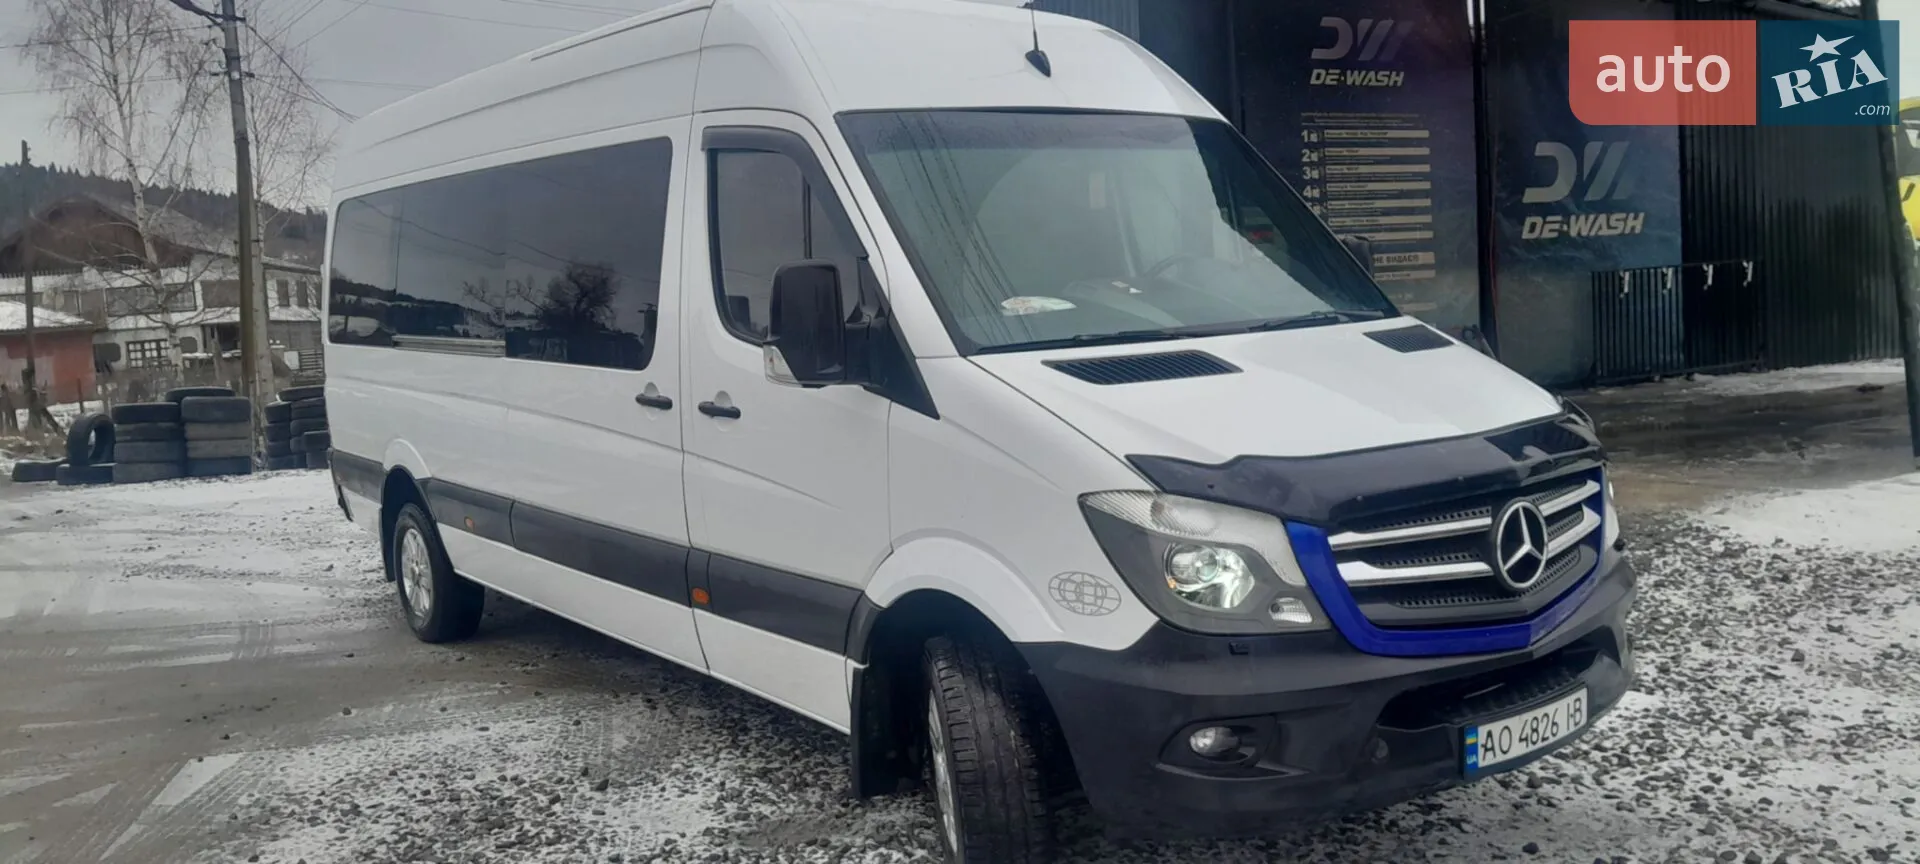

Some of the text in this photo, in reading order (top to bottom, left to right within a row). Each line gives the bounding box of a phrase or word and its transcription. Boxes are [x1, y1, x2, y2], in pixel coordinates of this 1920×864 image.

[1301, 148, 1311, 162] 2
[1302, 166, 1312, 180] 3
[1302, 184, 1312, 199] 4
[1482, 725, 1513, 762] AO
[1518, 707, 1560, 748] 4826
[1466, 754, 1478, 765] UA
